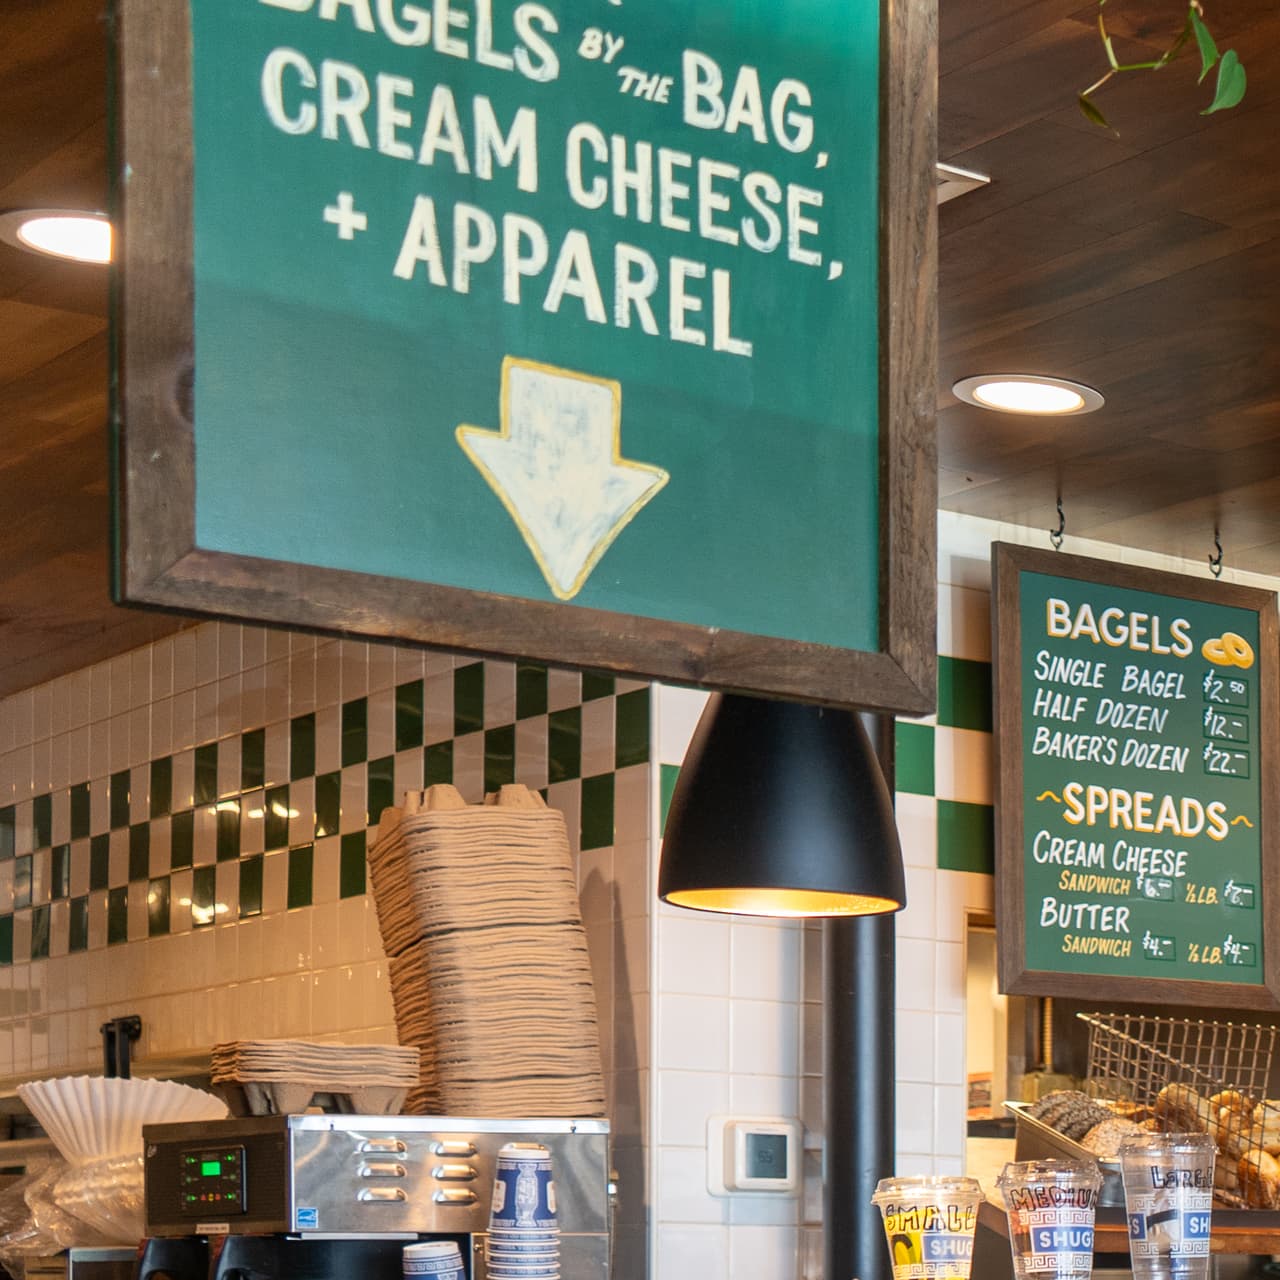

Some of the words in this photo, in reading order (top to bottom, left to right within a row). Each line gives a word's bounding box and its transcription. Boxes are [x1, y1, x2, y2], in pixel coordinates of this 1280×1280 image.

[578, 27, 624, 63] BY
[617, 67, 673, 104] THE
[682, 48, 828, 168] BAG,
[260, 47, 538, 192] CREAM
[565, 122, 842, 281] CHEESE,
[392, 194, 753, 356] APPAREL
[1046, 597, 1194, 658] BAGELS
[1033, 650, 1106, 689] SINGLE
[1121, 665, 1186, 699] BAGEL
[1032, 688, 1086, 723] HALF
[1096, 698, 1168, 734] DOZEN
[1032, 726, 1118, 767] BAKER'S
[1120, 739, 1189, 773] DOZEN
[1062, 781, 1229, 841] SPREADS
[1032, 829, 1106, 870] CREAM
[1112, 840, 1188, 878] CHEESE
[1058, 870, 1130, 895] SANDWICH
[1040, 897, 1129, 933] BUTTER
[1062, 934, 1131, 957] SANDWICH
